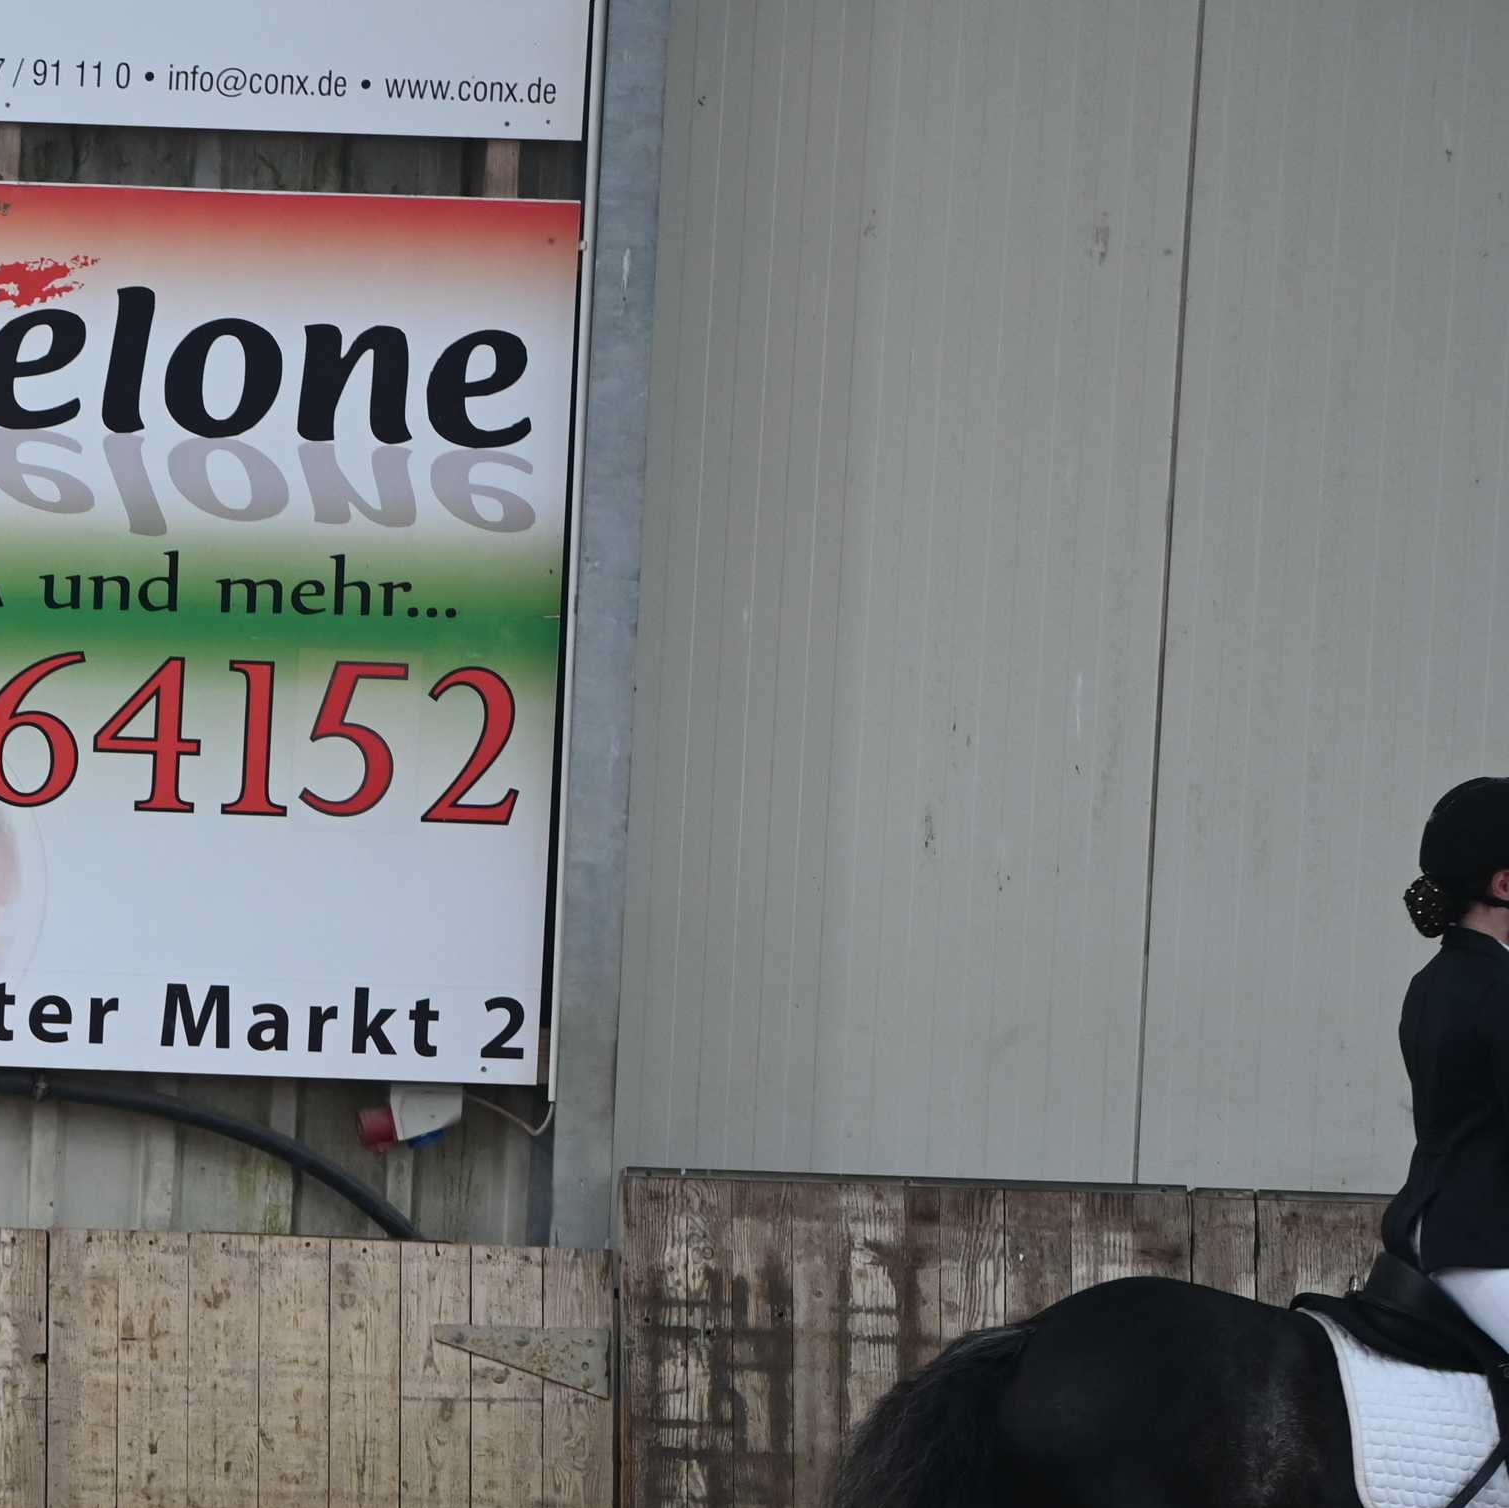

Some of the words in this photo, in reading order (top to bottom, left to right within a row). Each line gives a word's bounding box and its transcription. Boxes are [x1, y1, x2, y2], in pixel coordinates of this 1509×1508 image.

[31, 58, 62, 87] 91
[114, 61, 131, 89] 0
[167, 63, 348, 98] info@conx.de
[384, 76, 557, 105] www.conx.de
[39, 550, 181, 617] und
[214, 553, 458, 621] mehr...
[159, 981, 442, 1061] Markt
[480, 996, 529, 1062] 2
